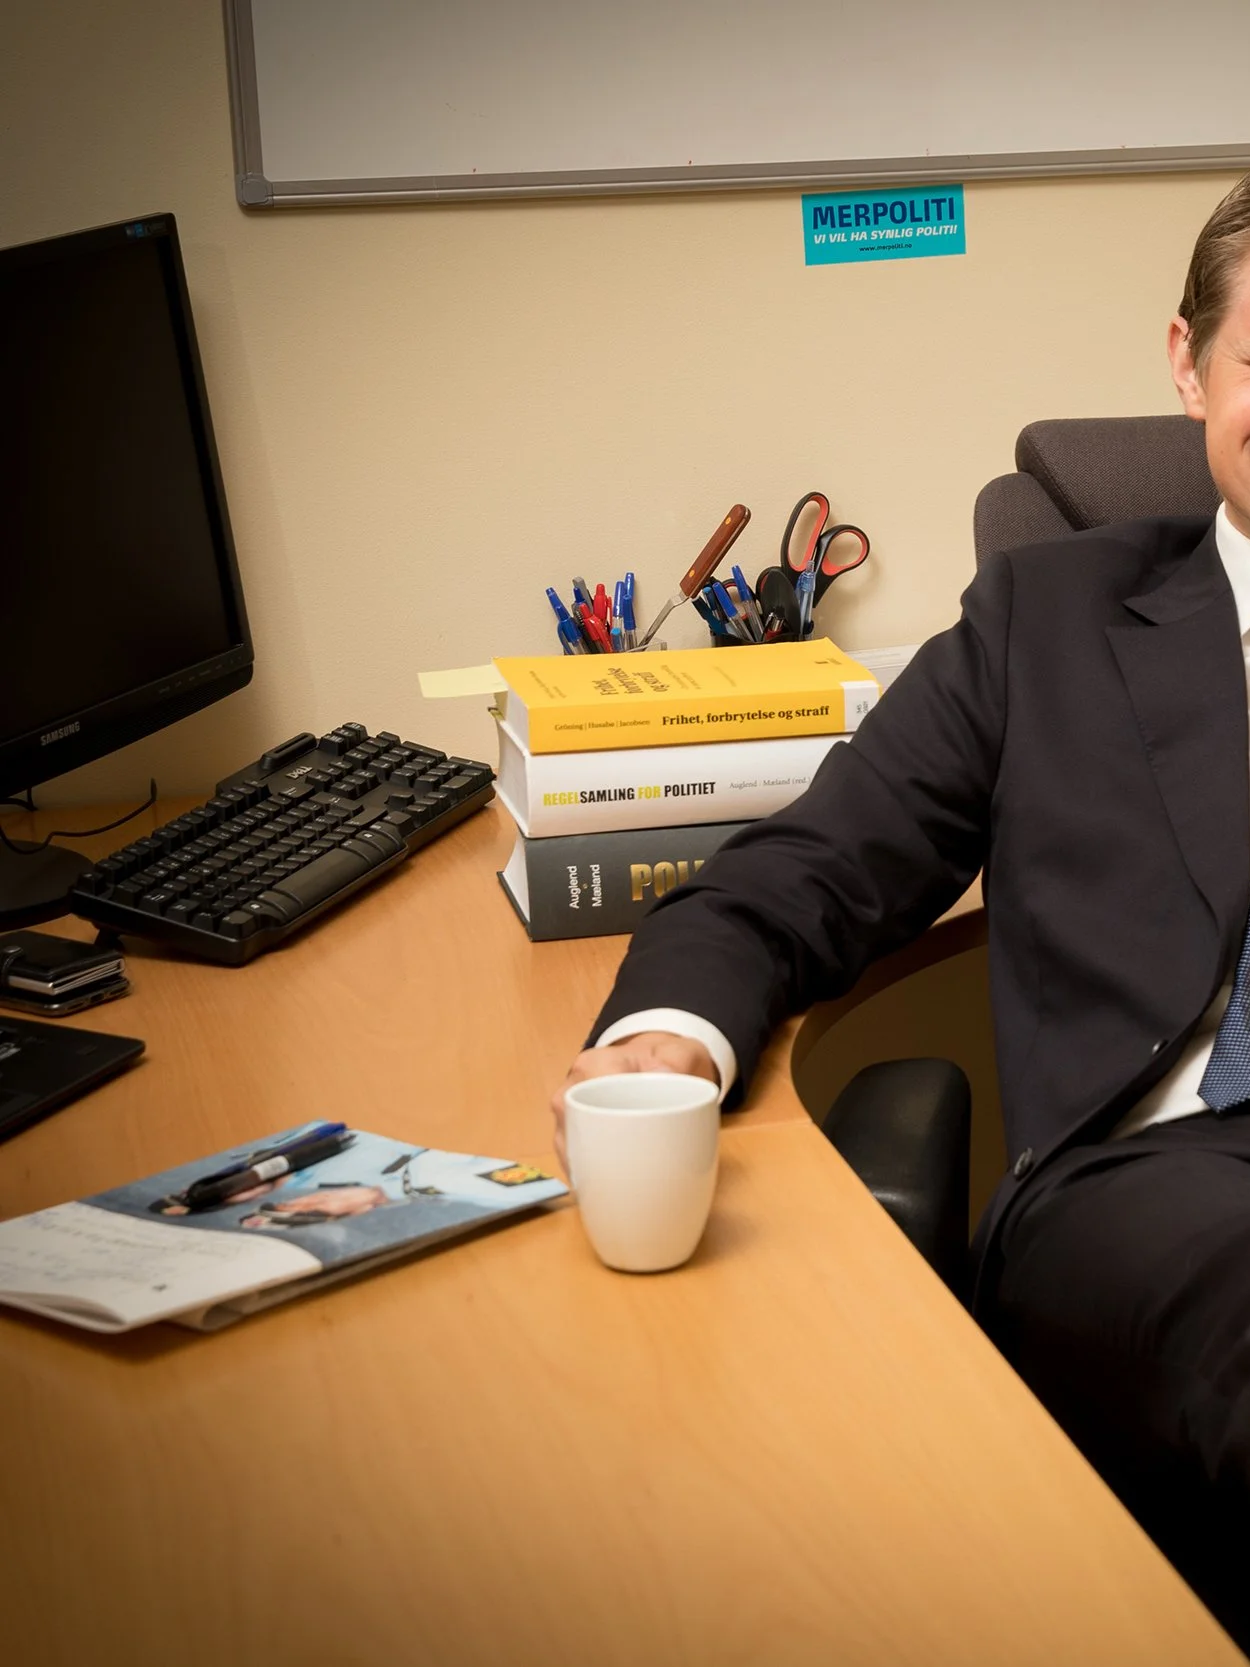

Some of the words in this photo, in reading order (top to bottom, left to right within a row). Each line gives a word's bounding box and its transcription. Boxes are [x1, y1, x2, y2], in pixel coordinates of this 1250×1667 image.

[812, 197, 955, 230] MERPOLITI
[813, 233, 827, 245] VI
[829, 232, 848, 243] VIL
[850, 230, 868, 242] HA
[870, 227, 914, 240] SYNLIG
[916, 224, 958, 237] POLITI!
[859, 243, 913, 252] www.merpoliti.no
[662, 714, 704, 725] Frihet,
[706, 709, 776, 724] forbrytelse
[778, 710, 793, 721] og
[795, 705, 830, 718] straff
[40, 721, 81, 747] SAMSUNG
[285, 765, 314, 780] DELL
[543, 787, 635, 806] REGELSAMLING
[637, 785, 661, 800] FOR
[664, 781, 716, 799] POLITIET
[729, 780, 757, 790] Auglend
[566, 864, 582, 909] Auglend
[589, 863, 603, 907] Mæland
